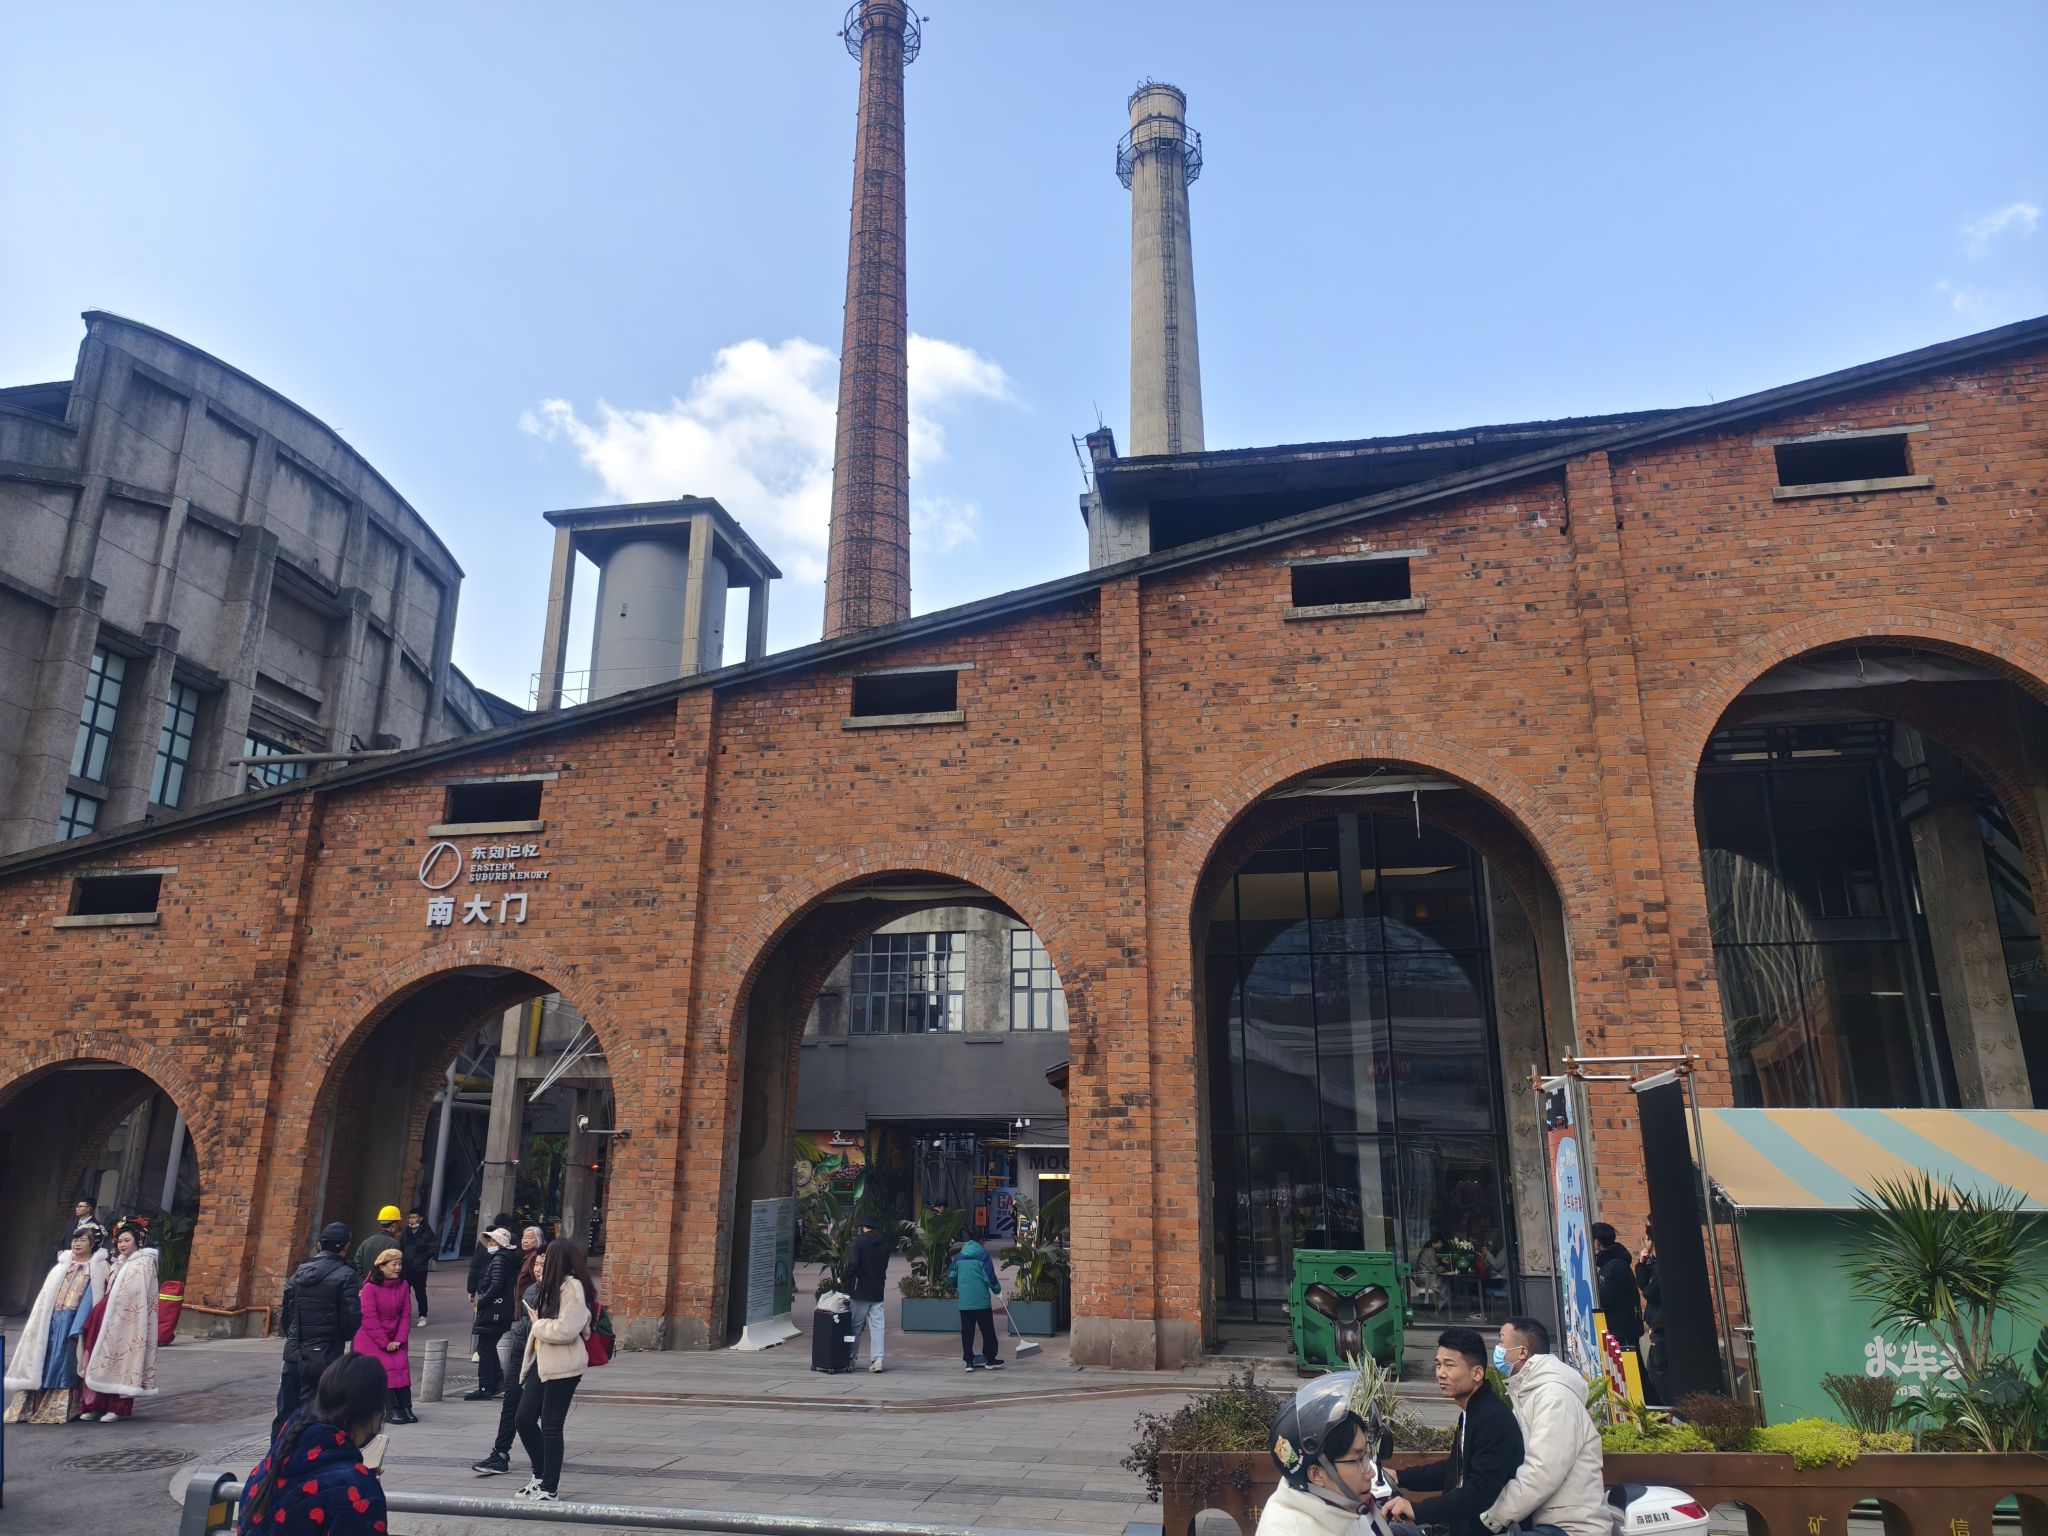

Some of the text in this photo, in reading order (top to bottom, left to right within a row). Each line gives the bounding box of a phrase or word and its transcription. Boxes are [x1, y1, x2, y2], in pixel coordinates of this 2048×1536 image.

[471, 843, 540, 860] 东郊记忆
[469, 870, 550, 882] SUBURB MEMORY
[470, 862, 516, 873] EASTERN
[426, 892, 528, 926] 南大门
[1949, 1518, 1970, 1536] 信
